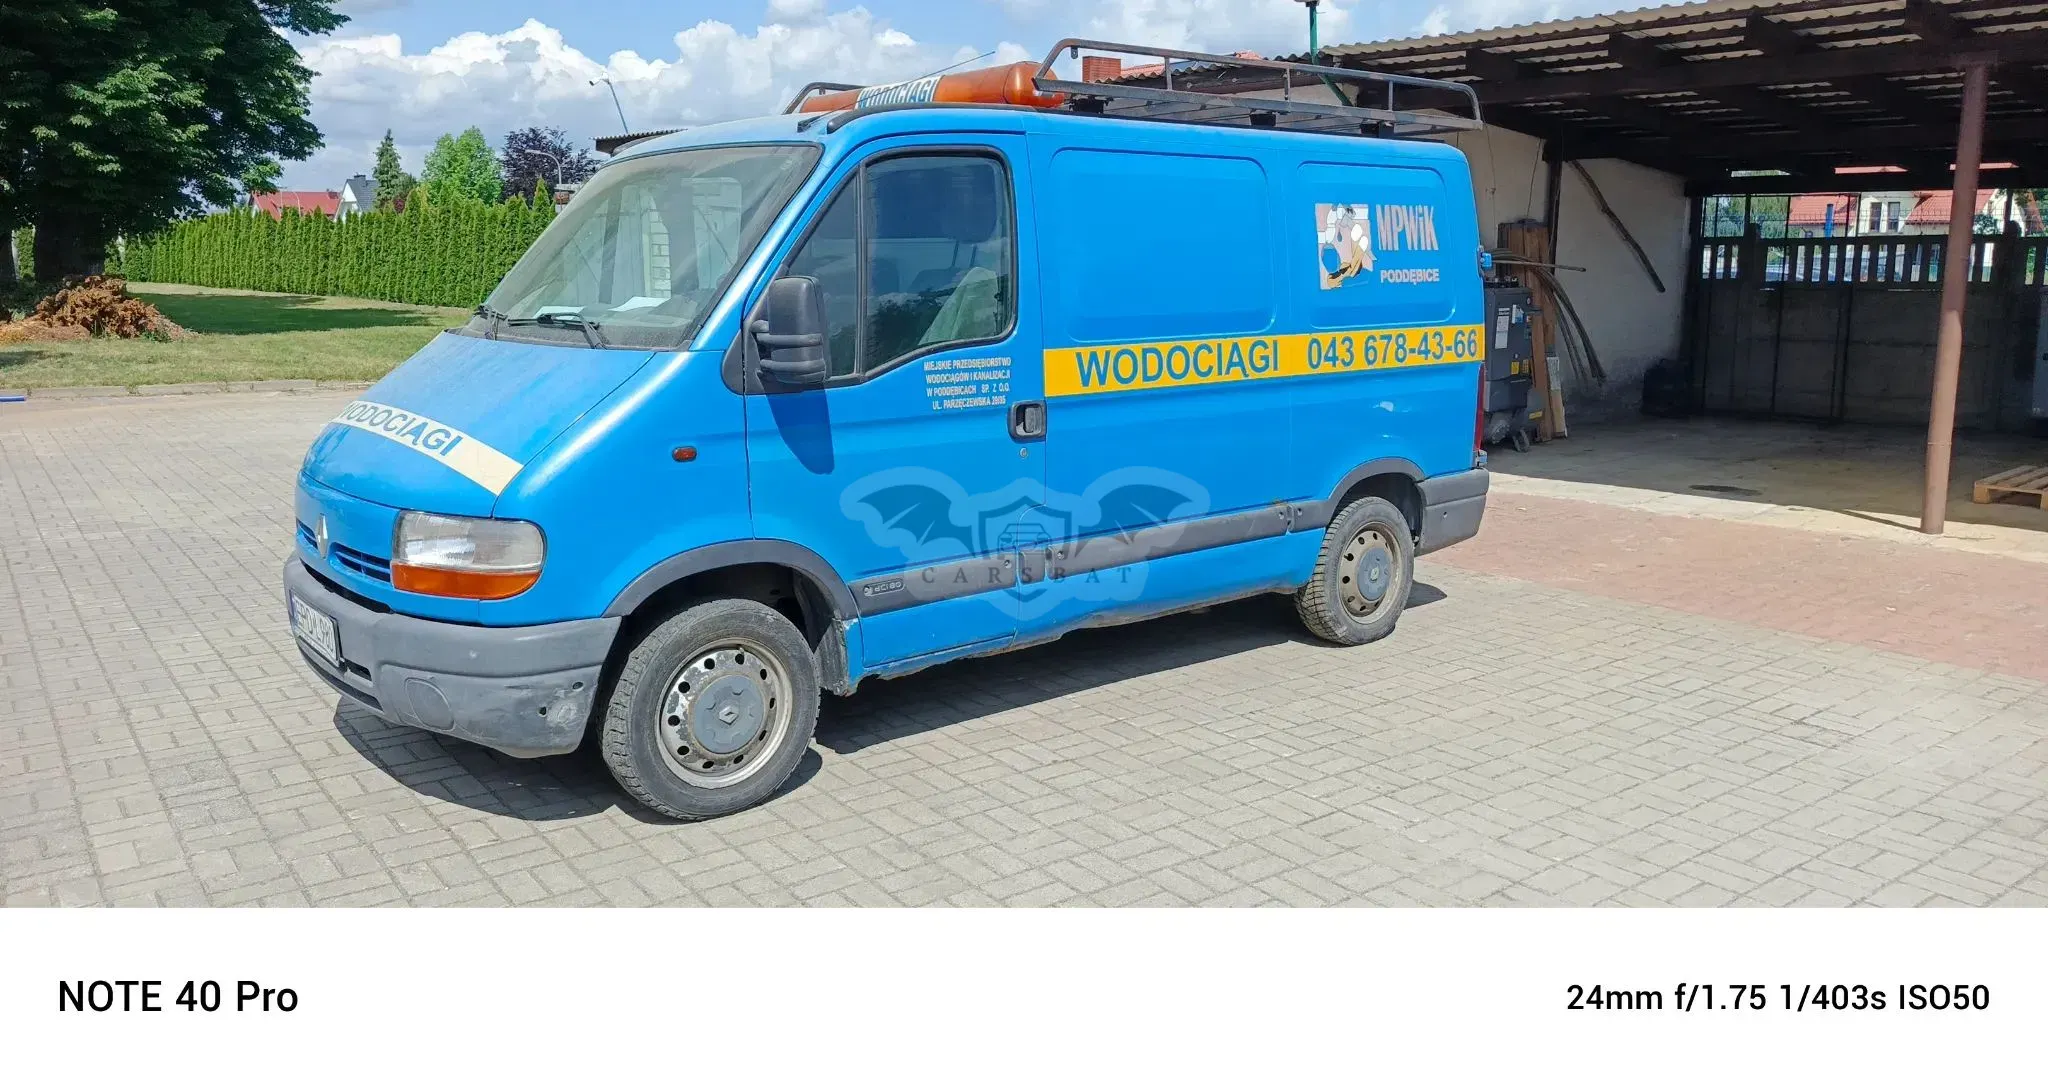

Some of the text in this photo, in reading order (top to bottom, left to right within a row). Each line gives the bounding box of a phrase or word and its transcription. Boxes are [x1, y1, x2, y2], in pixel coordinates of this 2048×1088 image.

[1376, 204, 1439, 250] MPWiK
[1380, 269, 1440, 285] PODDĘBICE
[924, 360, 951, 370] MIEJSKIE
[1075, 329, 1477, 388] WODOCIĄGI 043 678-43-66
[926, 387, 933, 397] W
